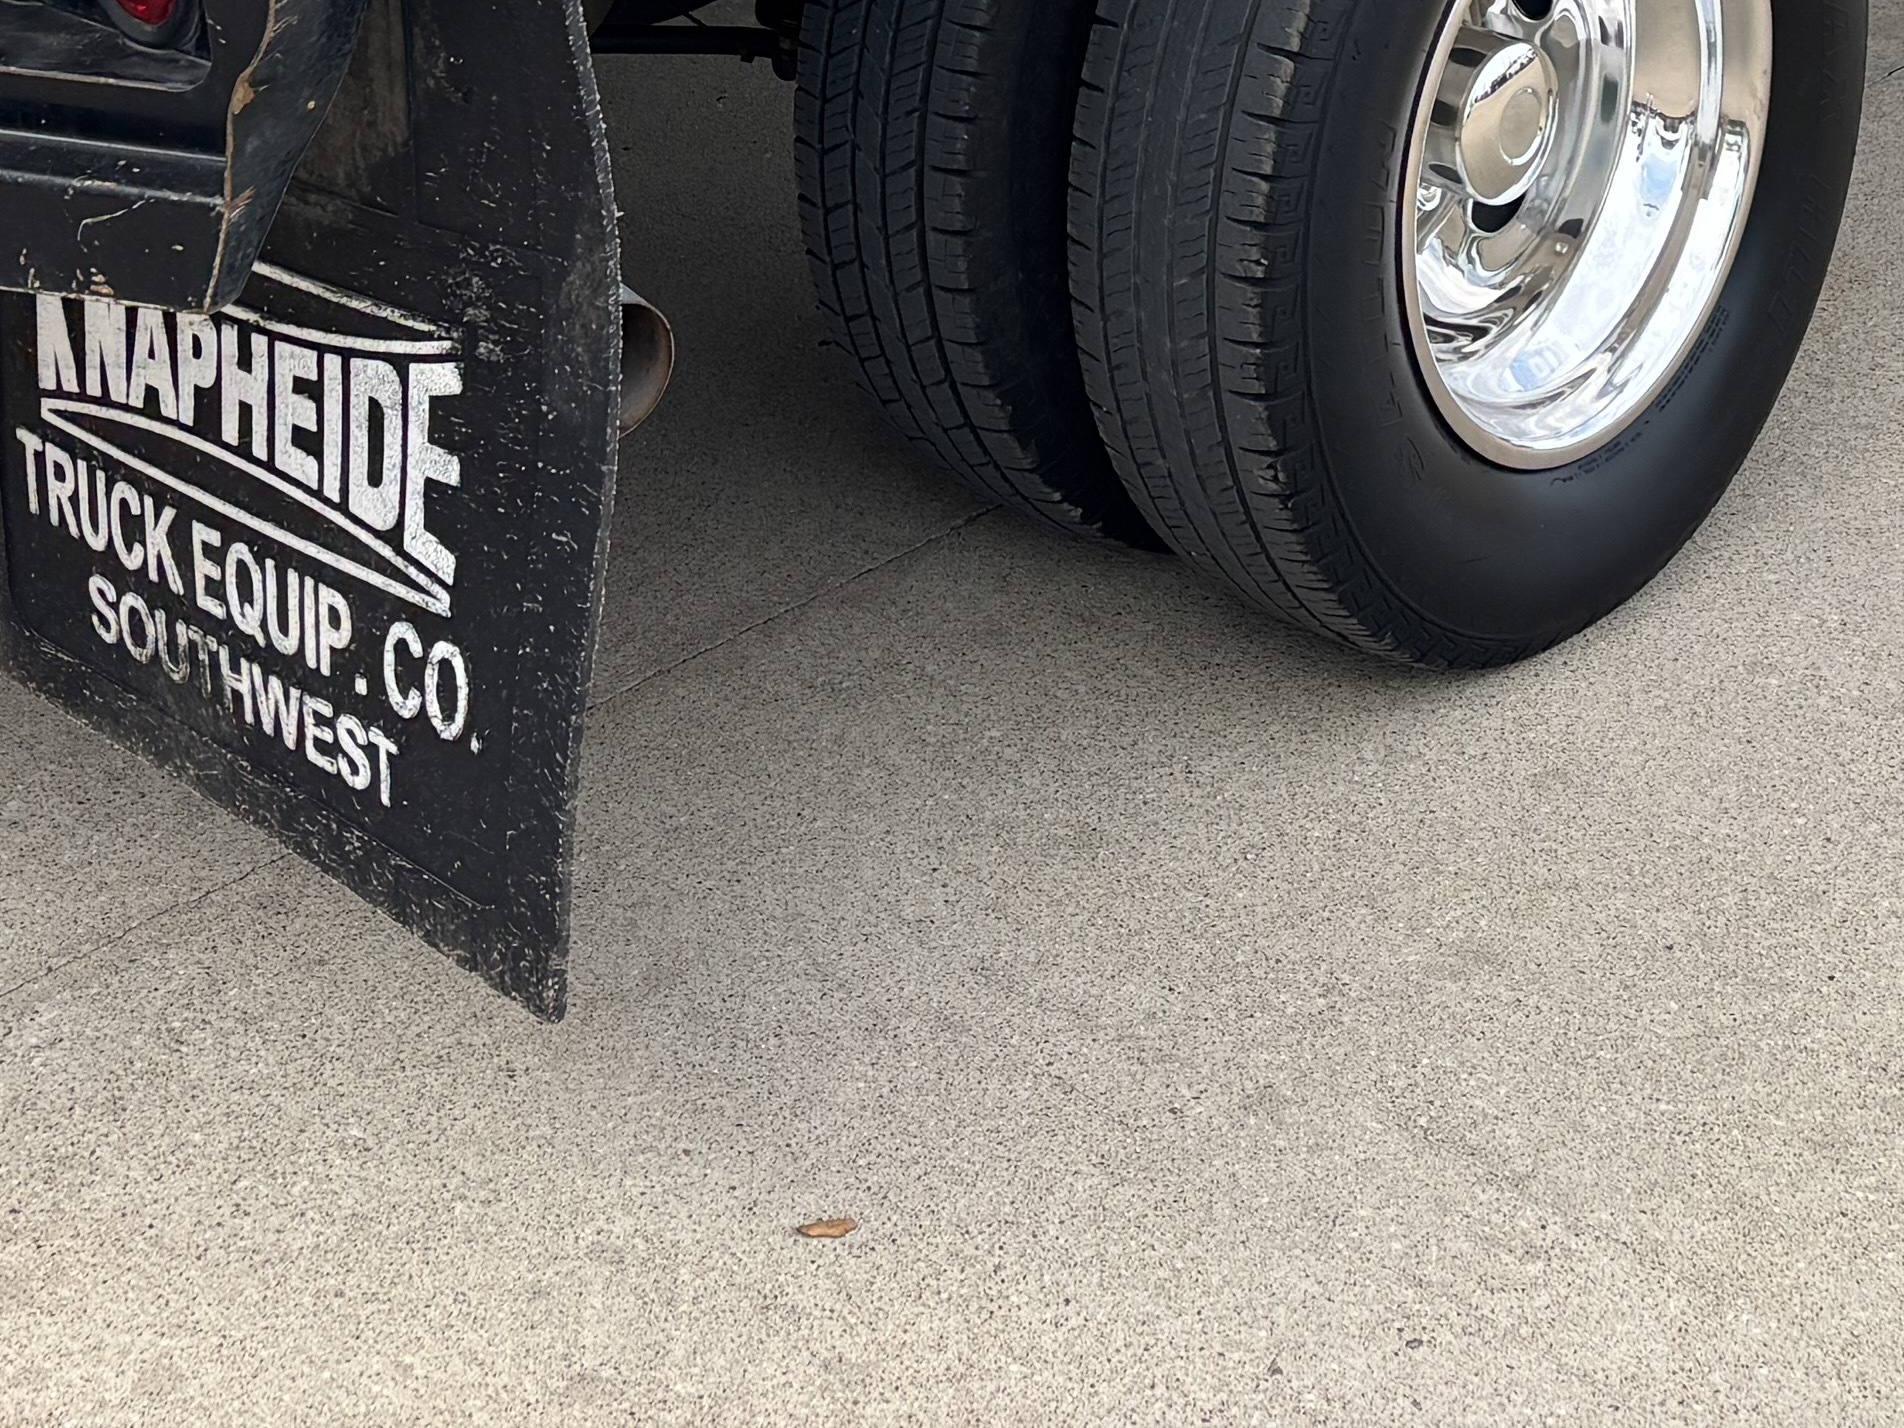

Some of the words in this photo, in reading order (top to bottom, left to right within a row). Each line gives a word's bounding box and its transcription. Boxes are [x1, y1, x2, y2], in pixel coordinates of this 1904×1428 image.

[15, 426, 183, 597] TRUCK
[35, 292, 463, 587] KNAPHEIDE
[88, 574, 400, 807] SOUTHWEST
